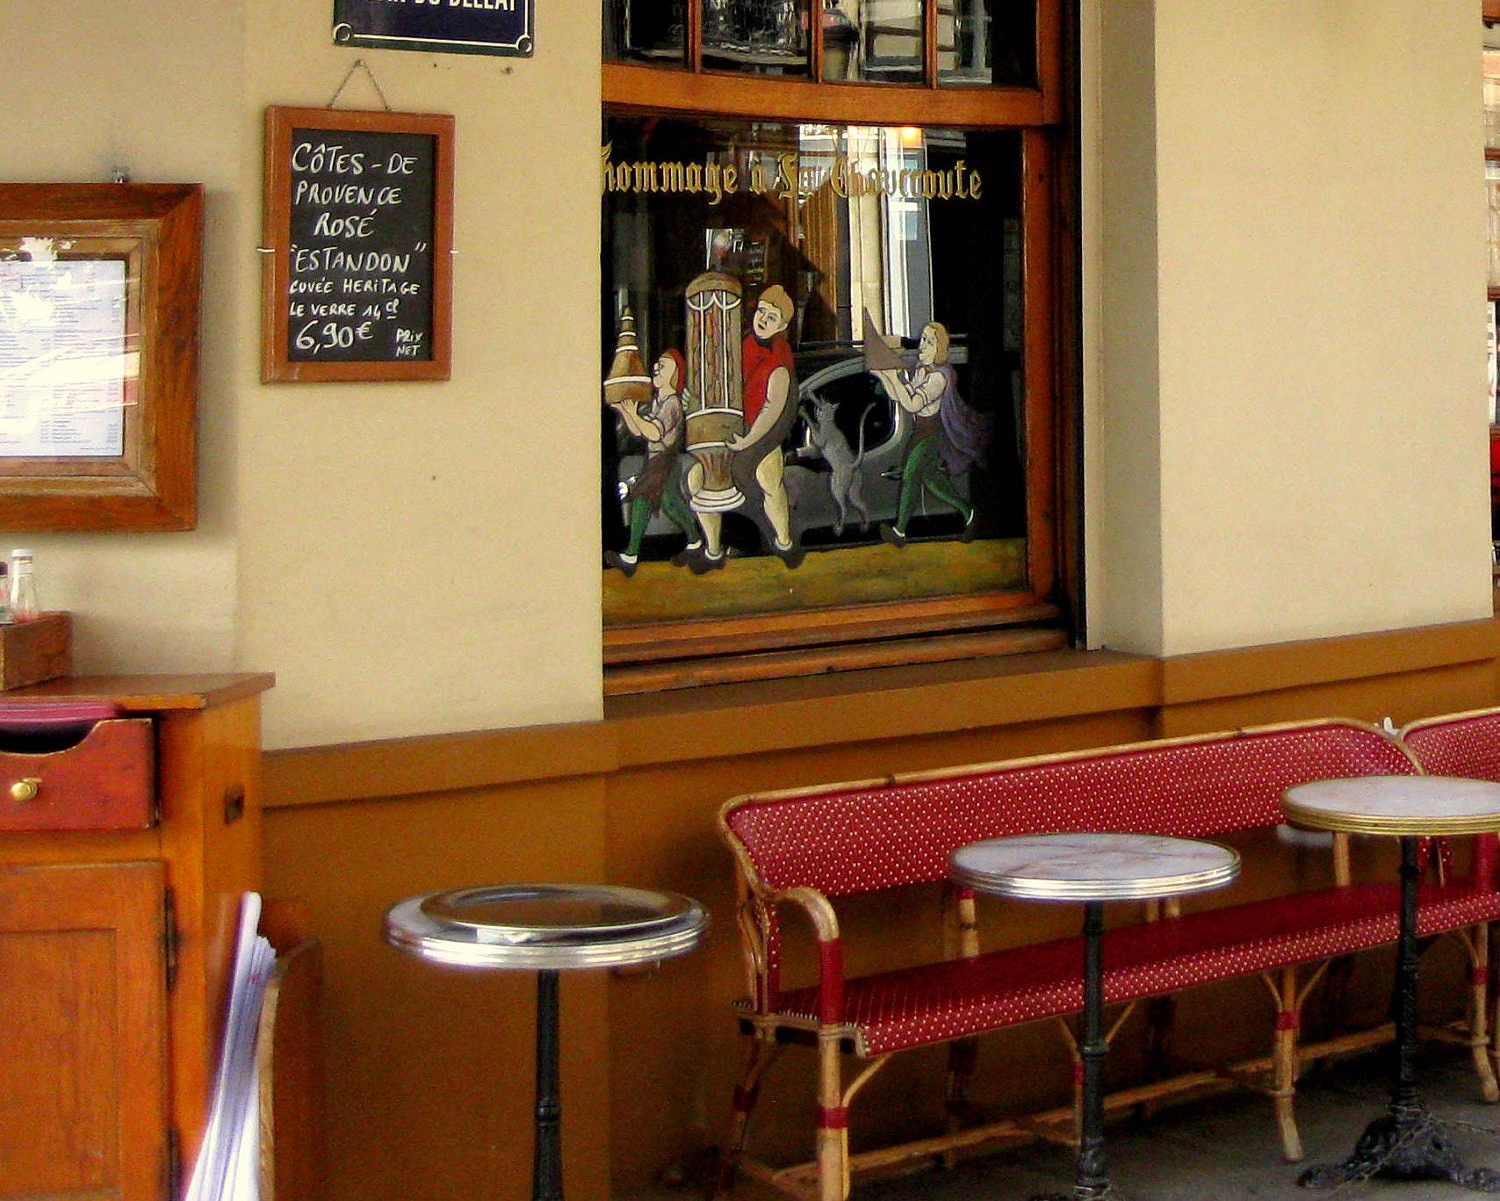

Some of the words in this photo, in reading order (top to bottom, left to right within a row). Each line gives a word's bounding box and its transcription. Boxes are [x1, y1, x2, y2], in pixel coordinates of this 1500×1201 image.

[295, 180, 402, 205] PROVENCE
[314, 209, 377, 237] ROSÉ
[290, 302, 304, 316] LE
[311, 303, 356, 316] VERRE
[296, 320, 374, 354] 6,90€
[396, 344, 420, 357] NET
